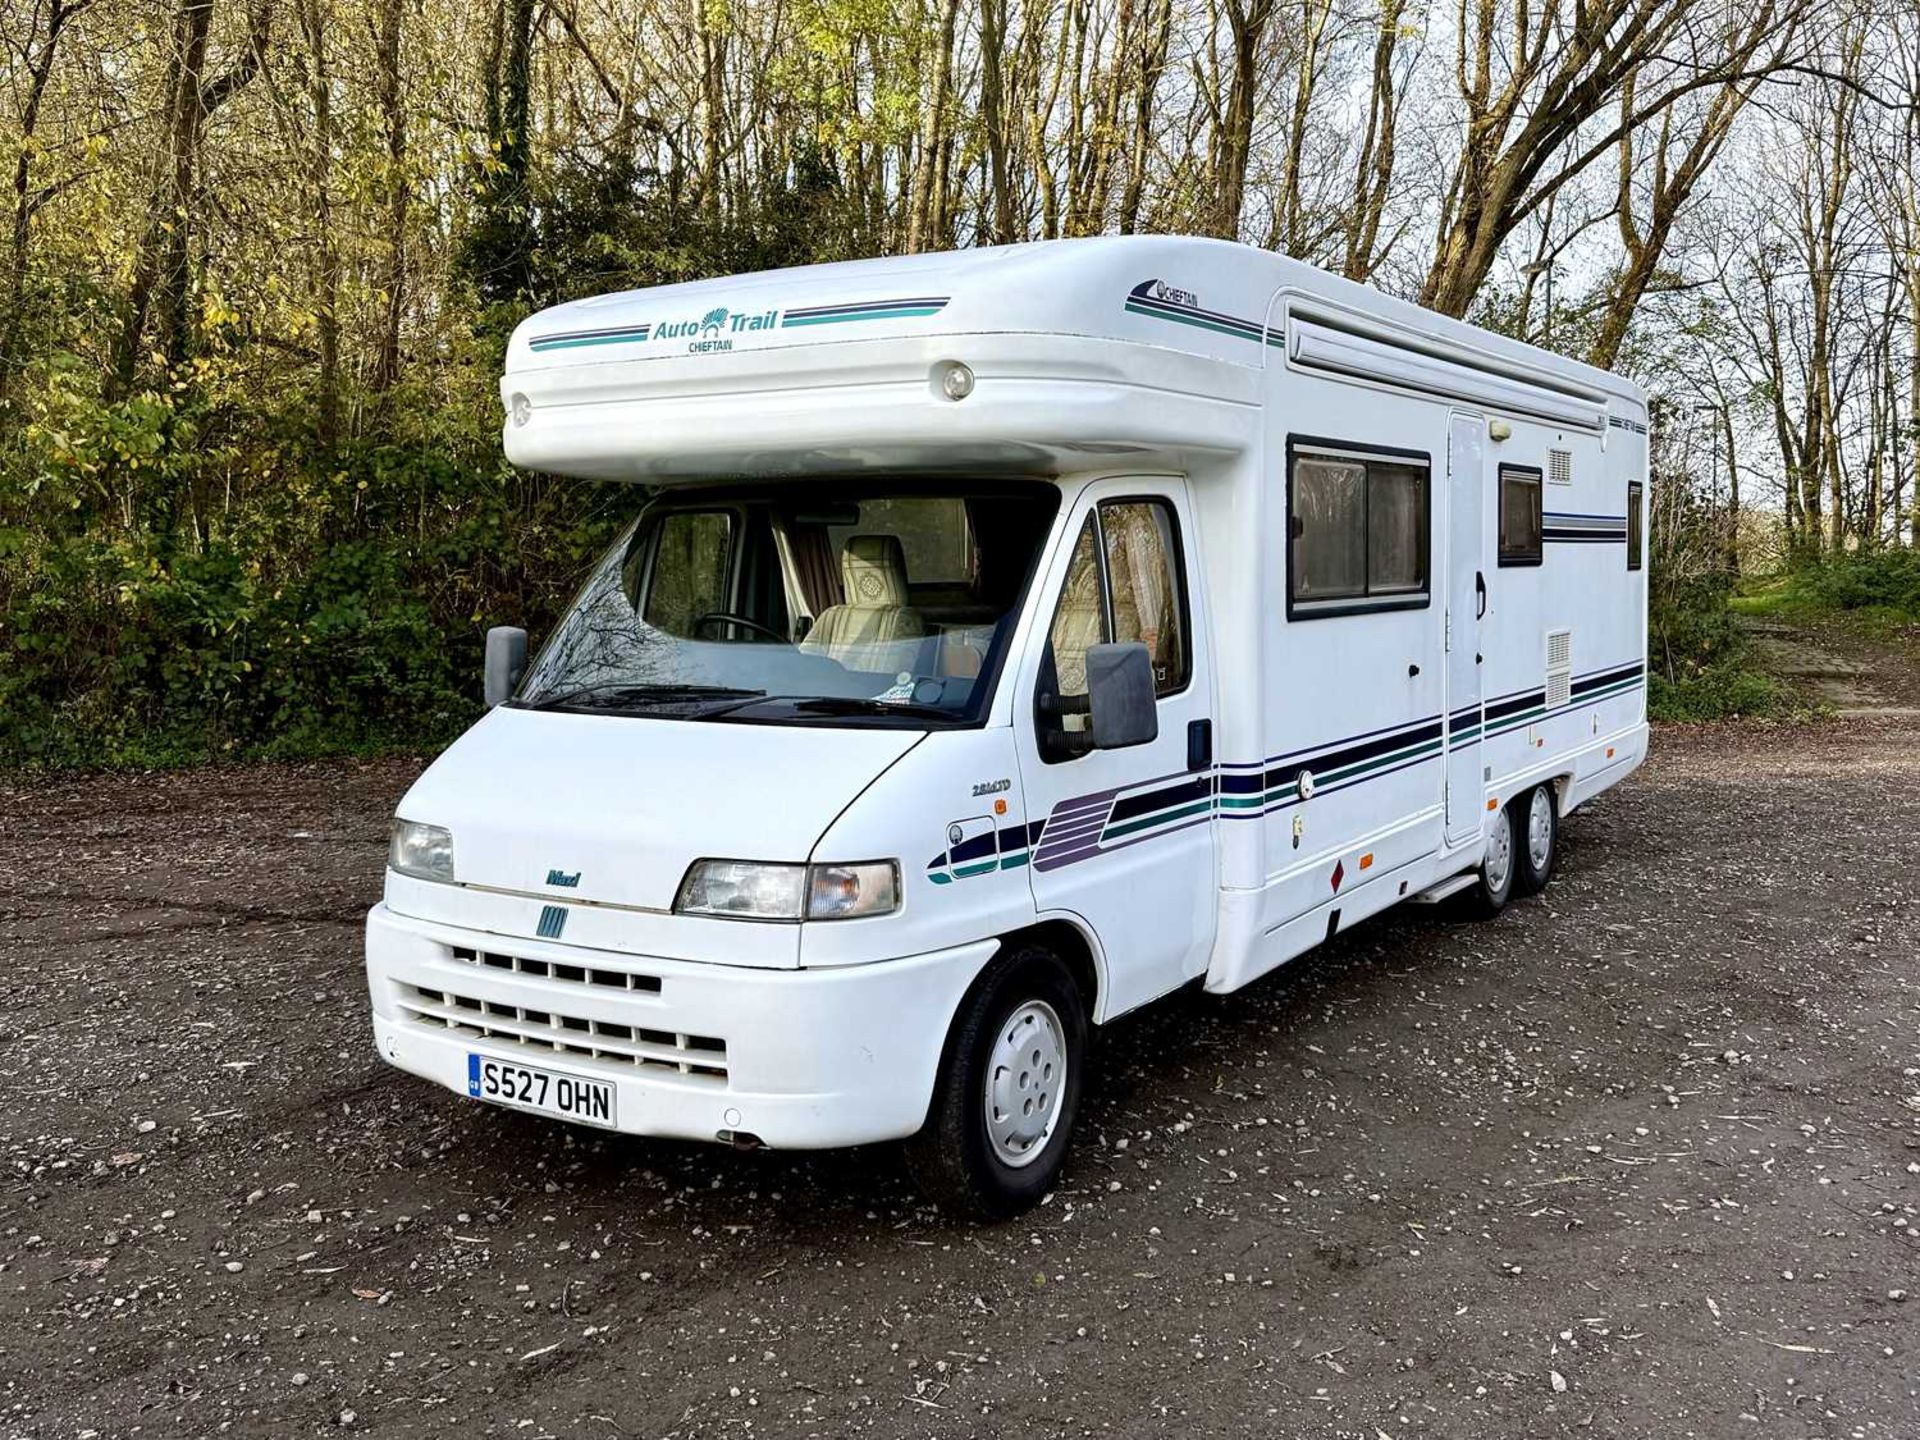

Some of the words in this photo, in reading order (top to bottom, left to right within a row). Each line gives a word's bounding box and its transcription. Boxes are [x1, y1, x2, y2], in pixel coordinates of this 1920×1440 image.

[1165, 286, 1198, 307] CHIEFTAIN
[653, 321, 699, 340] Auto
[729, 311, 778, 332] Trail
[688, 339, 733, 353] CHIEFTAIN
[484, 1063, 549, 1106] S527
[557, 1078, 609, 1120] OHN
